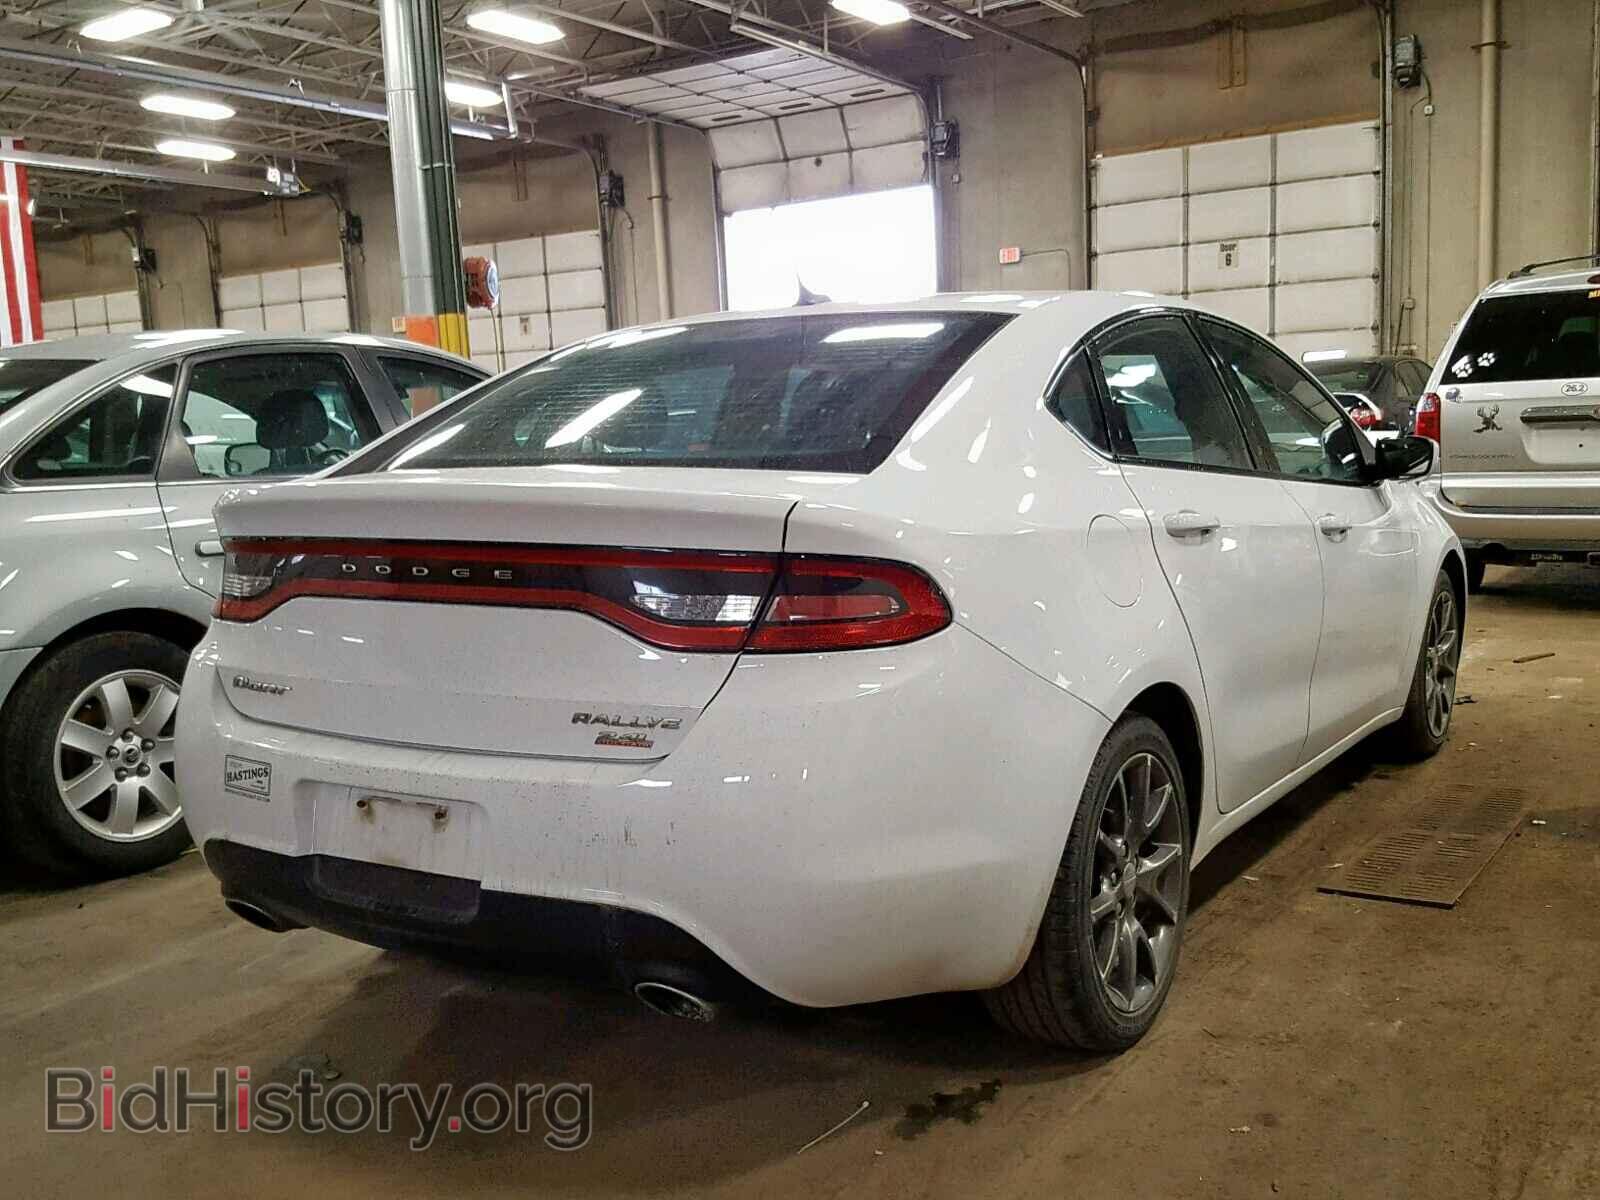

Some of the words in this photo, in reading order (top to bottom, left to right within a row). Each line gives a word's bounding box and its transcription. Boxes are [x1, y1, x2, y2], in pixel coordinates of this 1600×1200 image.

[1225, 253, 1232, 266] 6
[341, 562, 513, 580] DODGE
[571, 712, 683, 730] RALLYE
[226, 767, 269, 782] HASTINGS
